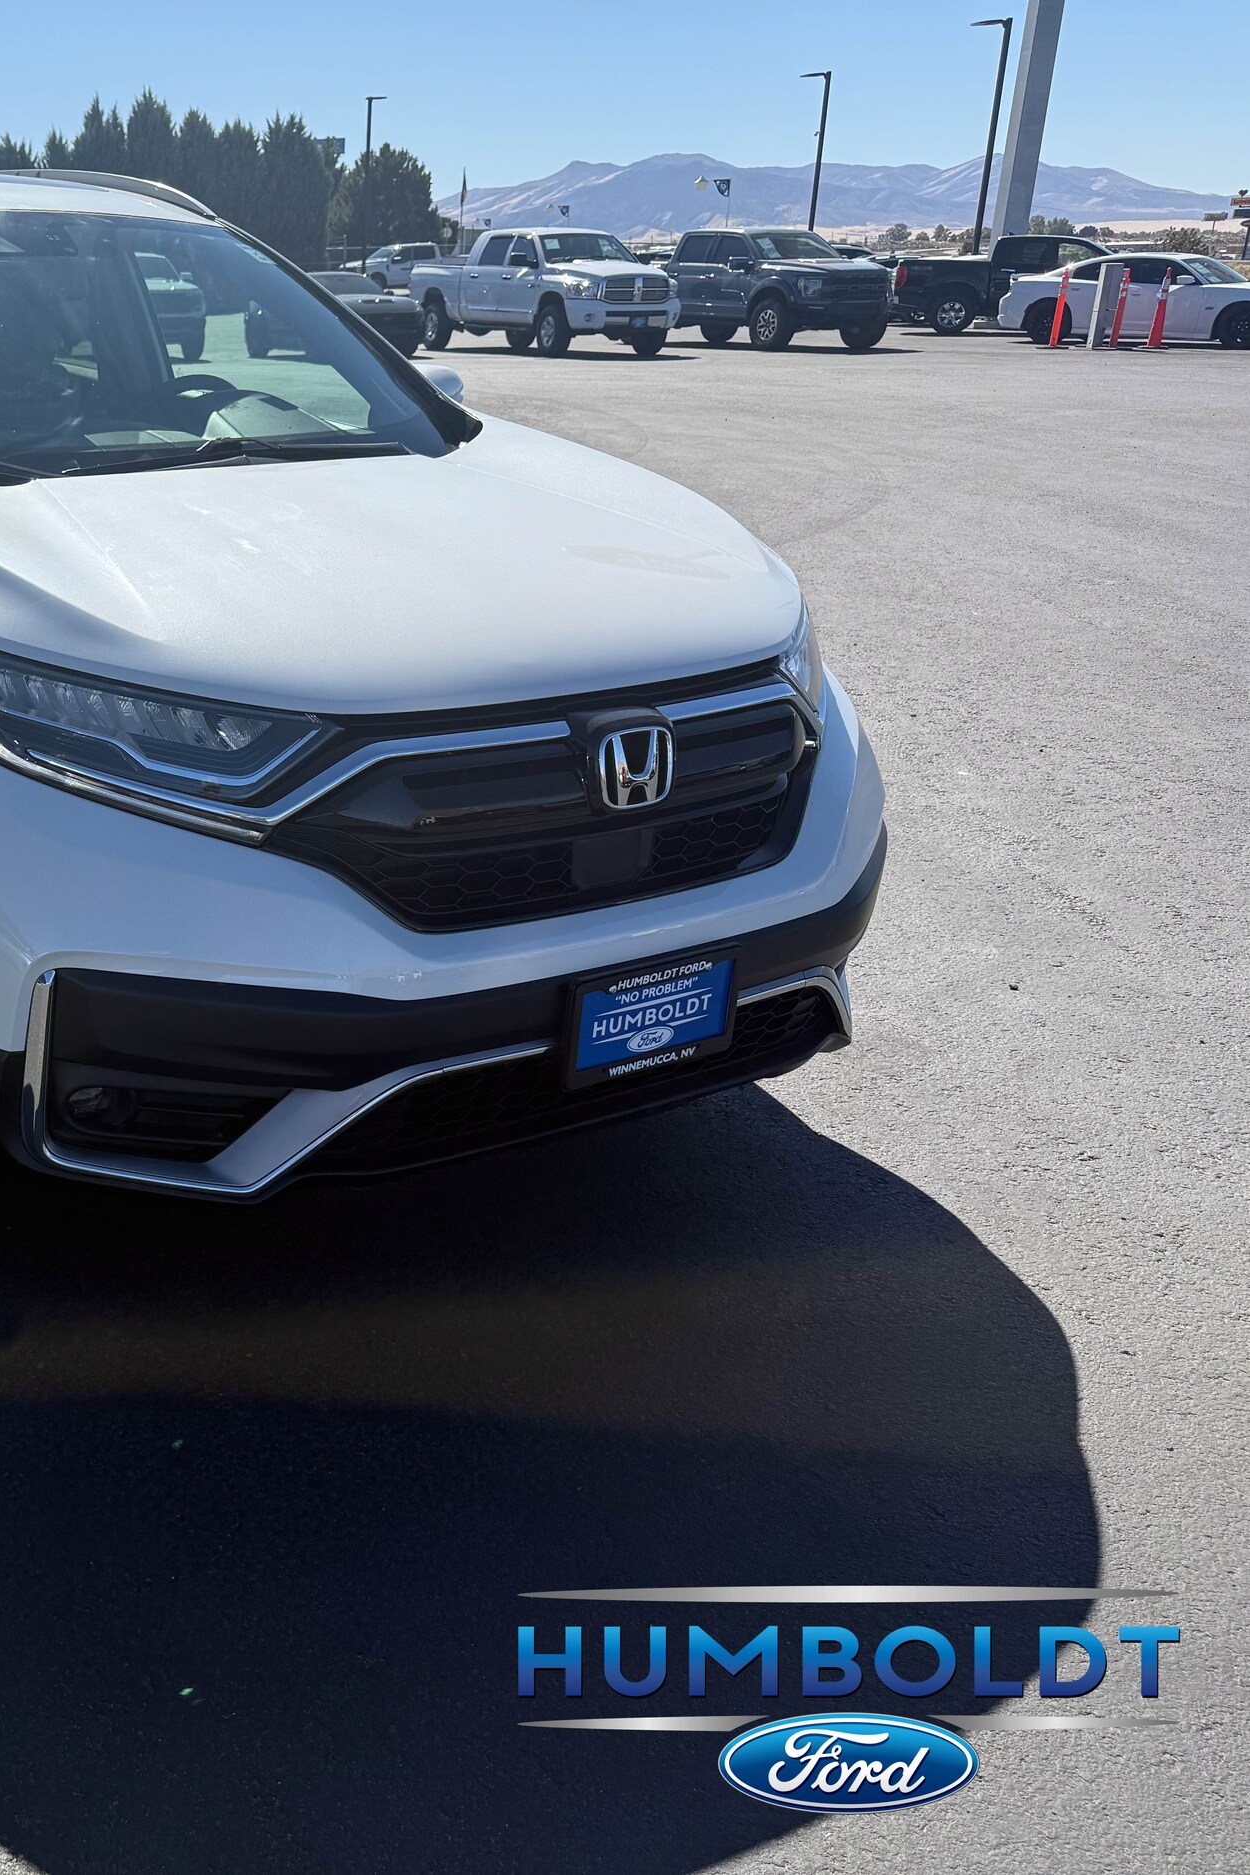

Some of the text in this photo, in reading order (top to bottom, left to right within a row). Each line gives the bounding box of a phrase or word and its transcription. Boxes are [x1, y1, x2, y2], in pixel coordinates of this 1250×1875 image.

[617, 961, 707, 991] HUMBOLDT FORD
[592, 994, 712, 1038] HUMBOLDT
[637, 1030, 664, 1048] Ford
[609, 1046, 696, 1077] WINNEMUCCA, NV
